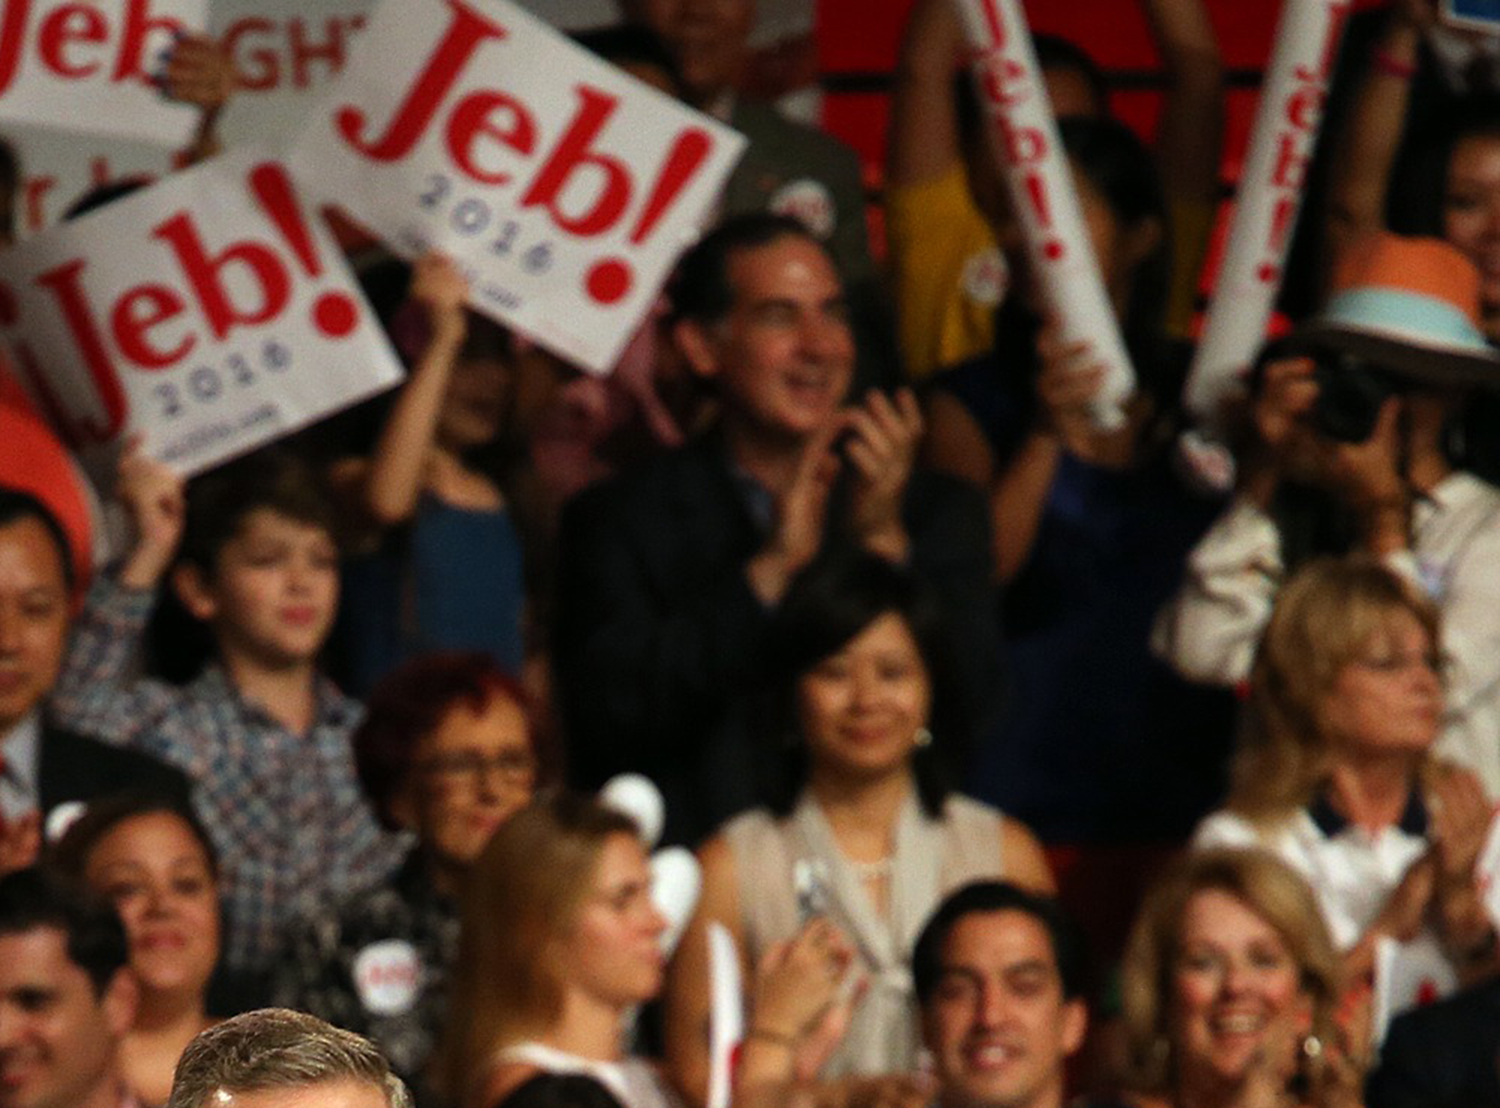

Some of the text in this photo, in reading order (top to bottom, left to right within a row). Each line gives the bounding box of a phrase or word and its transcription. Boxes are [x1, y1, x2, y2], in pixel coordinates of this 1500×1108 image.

[333, 0, 716, 308] Jeb!
[418, 173, 555, 276] 2016
[152, 340, 293, 420] 2016
